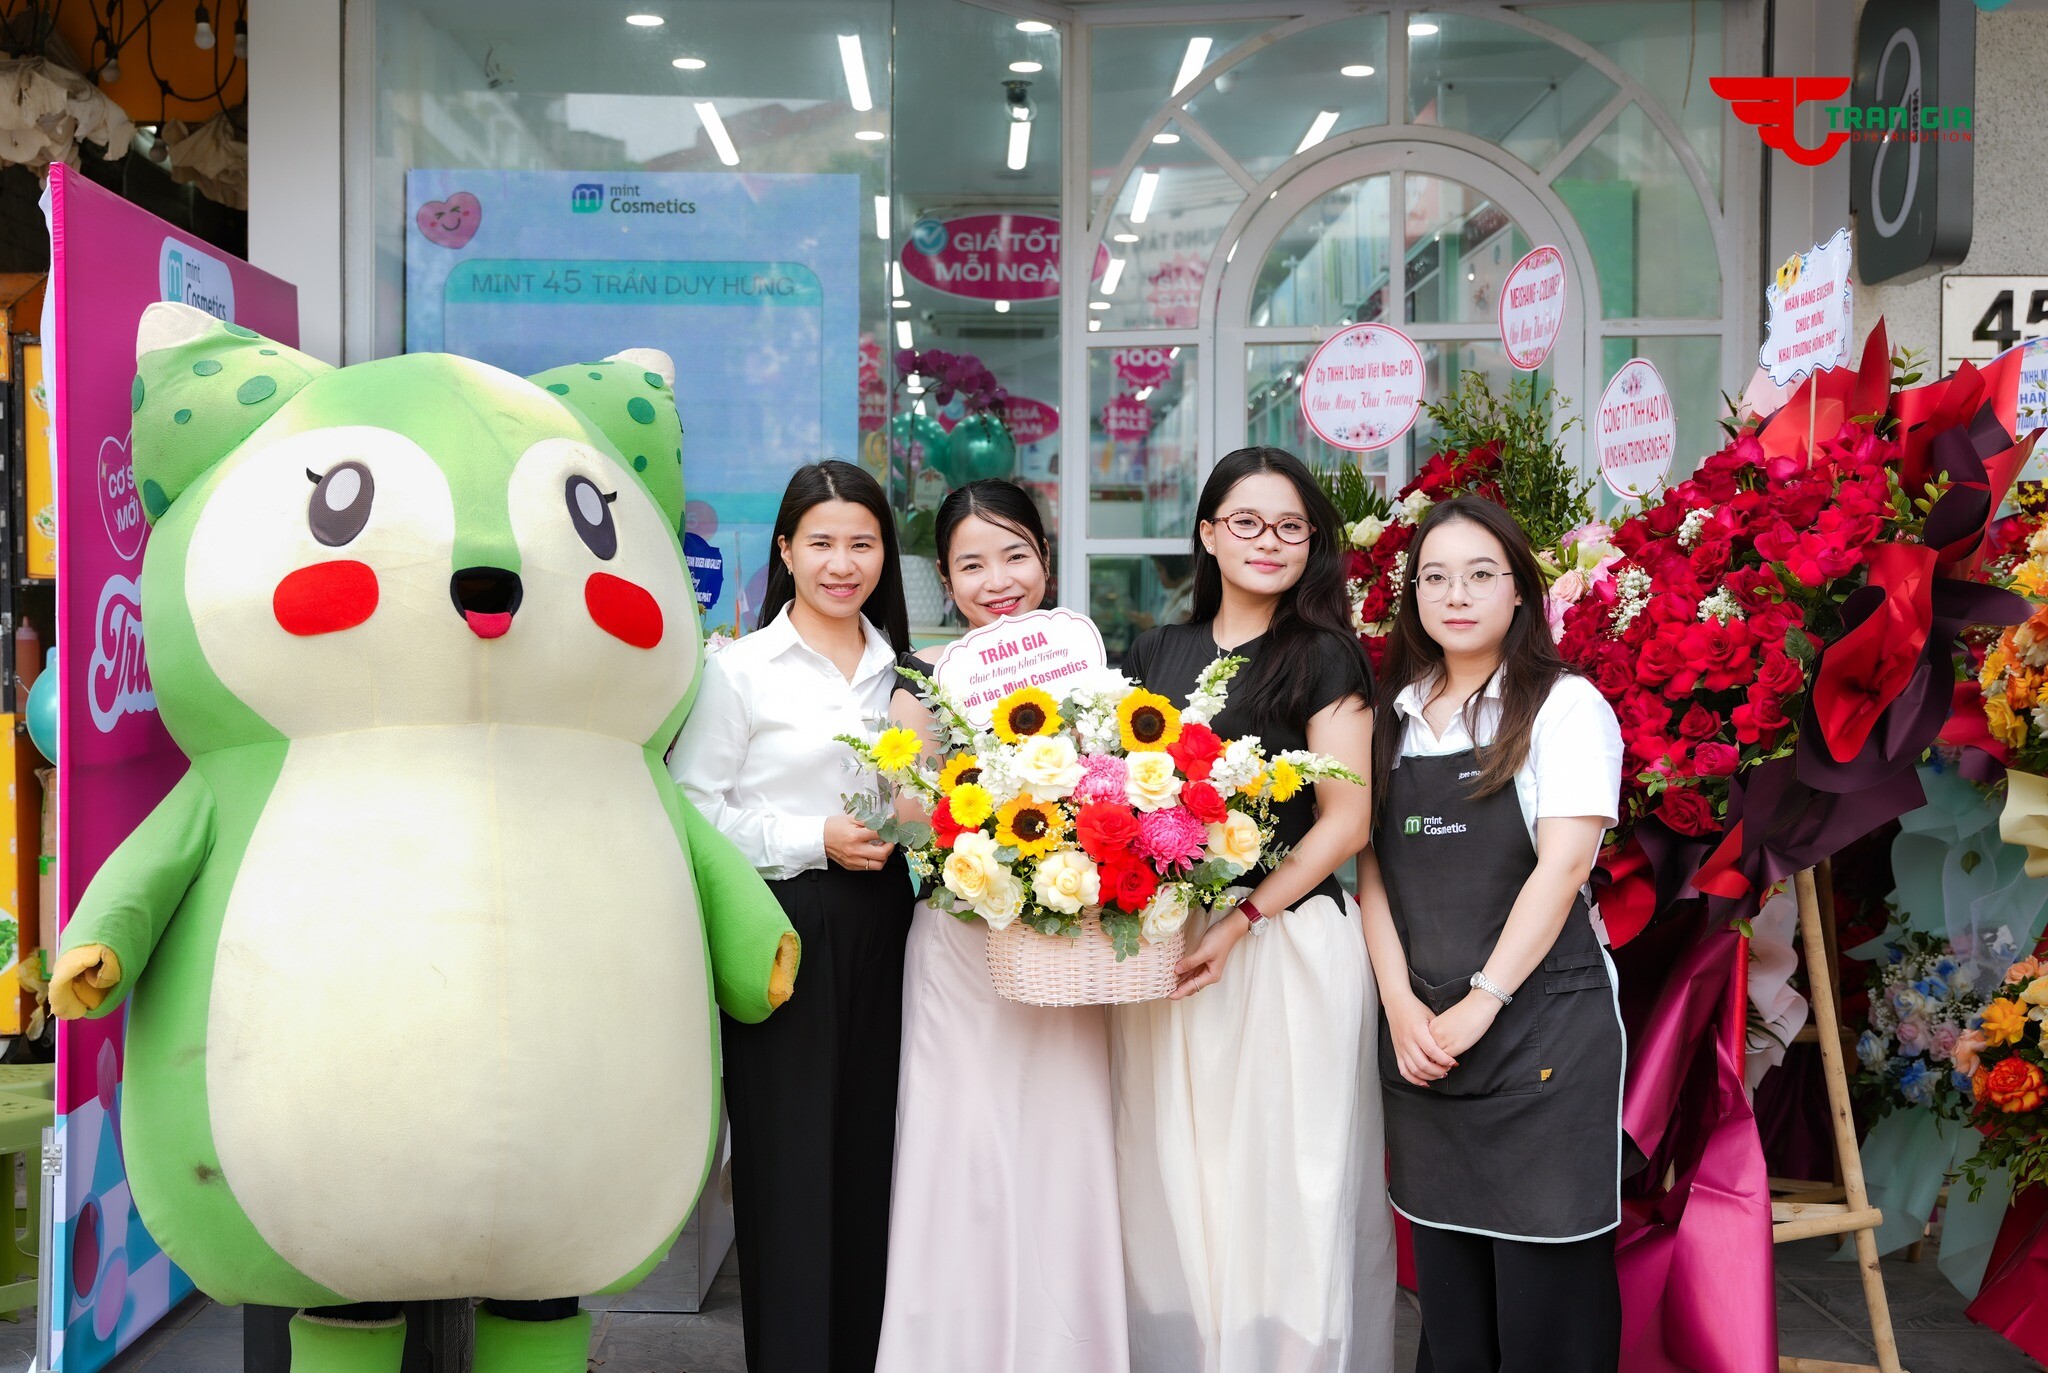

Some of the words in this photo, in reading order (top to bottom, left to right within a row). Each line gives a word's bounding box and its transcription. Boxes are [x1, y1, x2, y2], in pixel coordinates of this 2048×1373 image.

[610, 184, 640, 197] mint
[610, 197, 696, 214] Cosmetics
[953, 228, 1004, 252] GIÁ
[1008, 226, 1060, 253] TỐT
[185, 258, 201, 283] mint
[934, 253, 991, 282] MỖI
[996, 258, 1060, 283] NGÀ
[471, 273, 535, 294] MINT
[542, 269, 583, 294] 45
[665, 275, 716, 296] DUY
[1158, 277, 1201, 292] SAL
[1158, 294, 1199, 309] SAL
[1315, 367, 1326, 387] Cty
[1327, 366, 1345, 382] TNHH
[1108, 407, 1147, 419] SALE
[1621, 403, 1629, 430] TY
[1108, 419, 1147, 431] SALE
[108, 464, 126, 499] CƠ
[127, 464, 135, 490] S
[116, 494, 140, 533] MỚI
[978, 639, 1020, 666] TRẦN
[1021, 631, 1049, 652] GIA
[1003, 677, 1029, 696] Mint
[1031, 659, 1088, 686] Cosmetics
[1423, 815, 1443, 825] mint
[1423, 823, 1467, 835] Cosmetics
